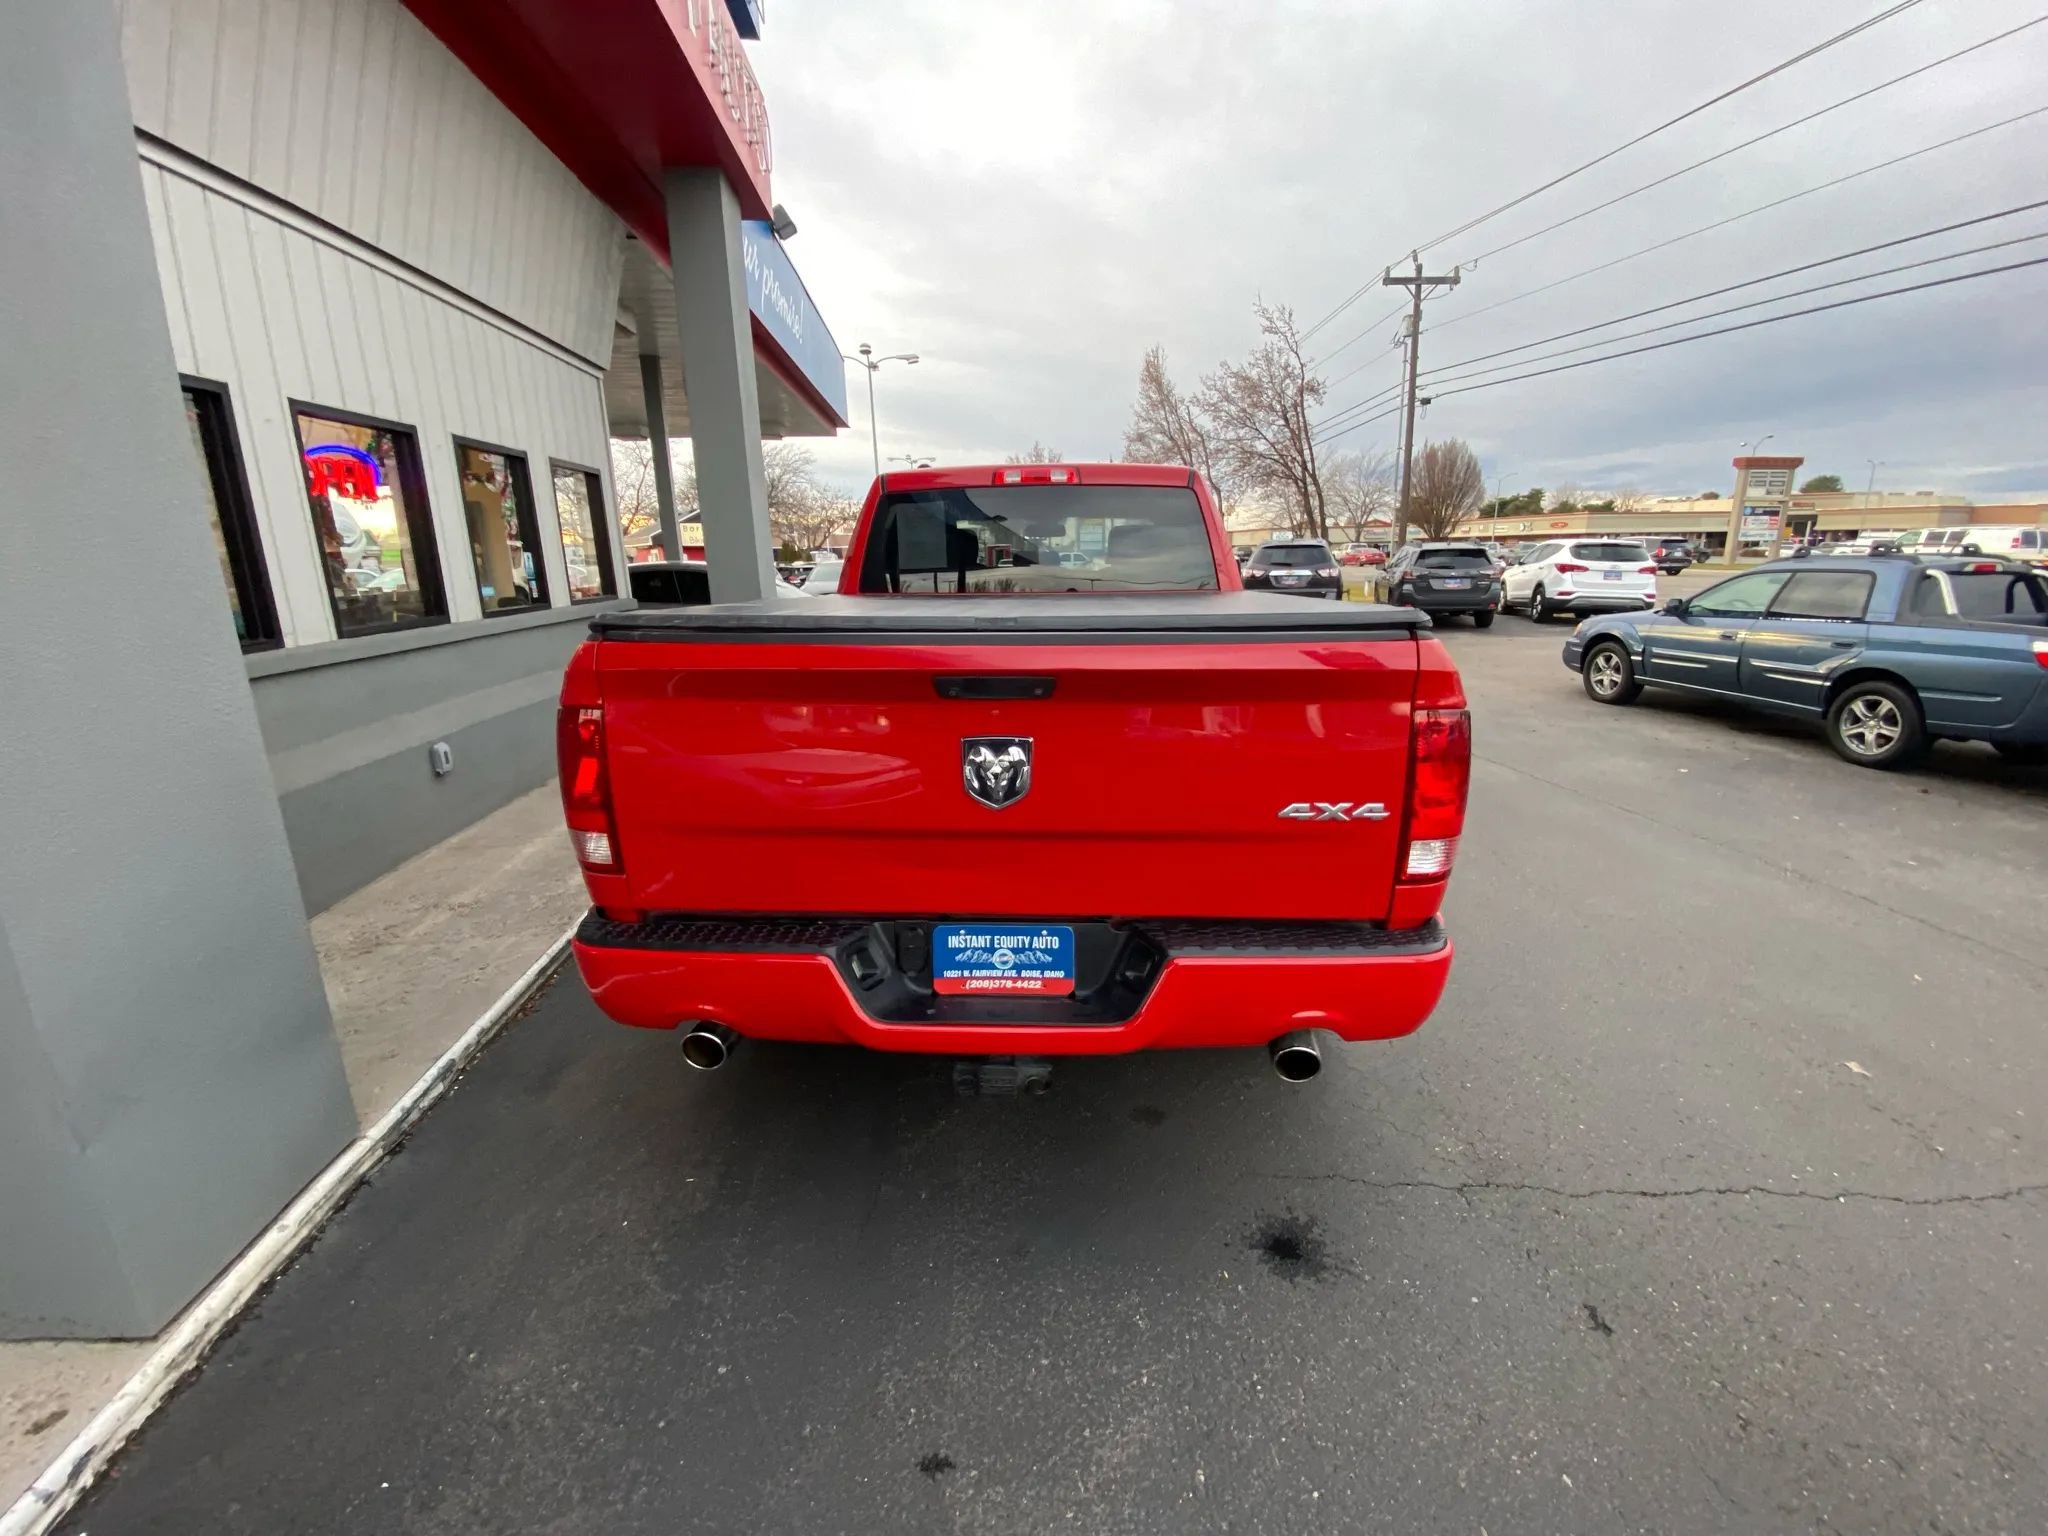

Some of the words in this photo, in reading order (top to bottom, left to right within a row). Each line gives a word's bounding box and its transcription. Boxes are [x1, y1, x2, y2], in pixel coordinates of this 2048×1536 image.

[761, 264, 805, 345] promise!
[948, 935, 991, 948] INSTANT
[994, 936, 1030, 948] EQUITY
[1032, 936, 1060, 949] AUTO
[971, 970, 1003, 978] FAIRVIEW
[1021, 970, 1043, 979] BOISE,
